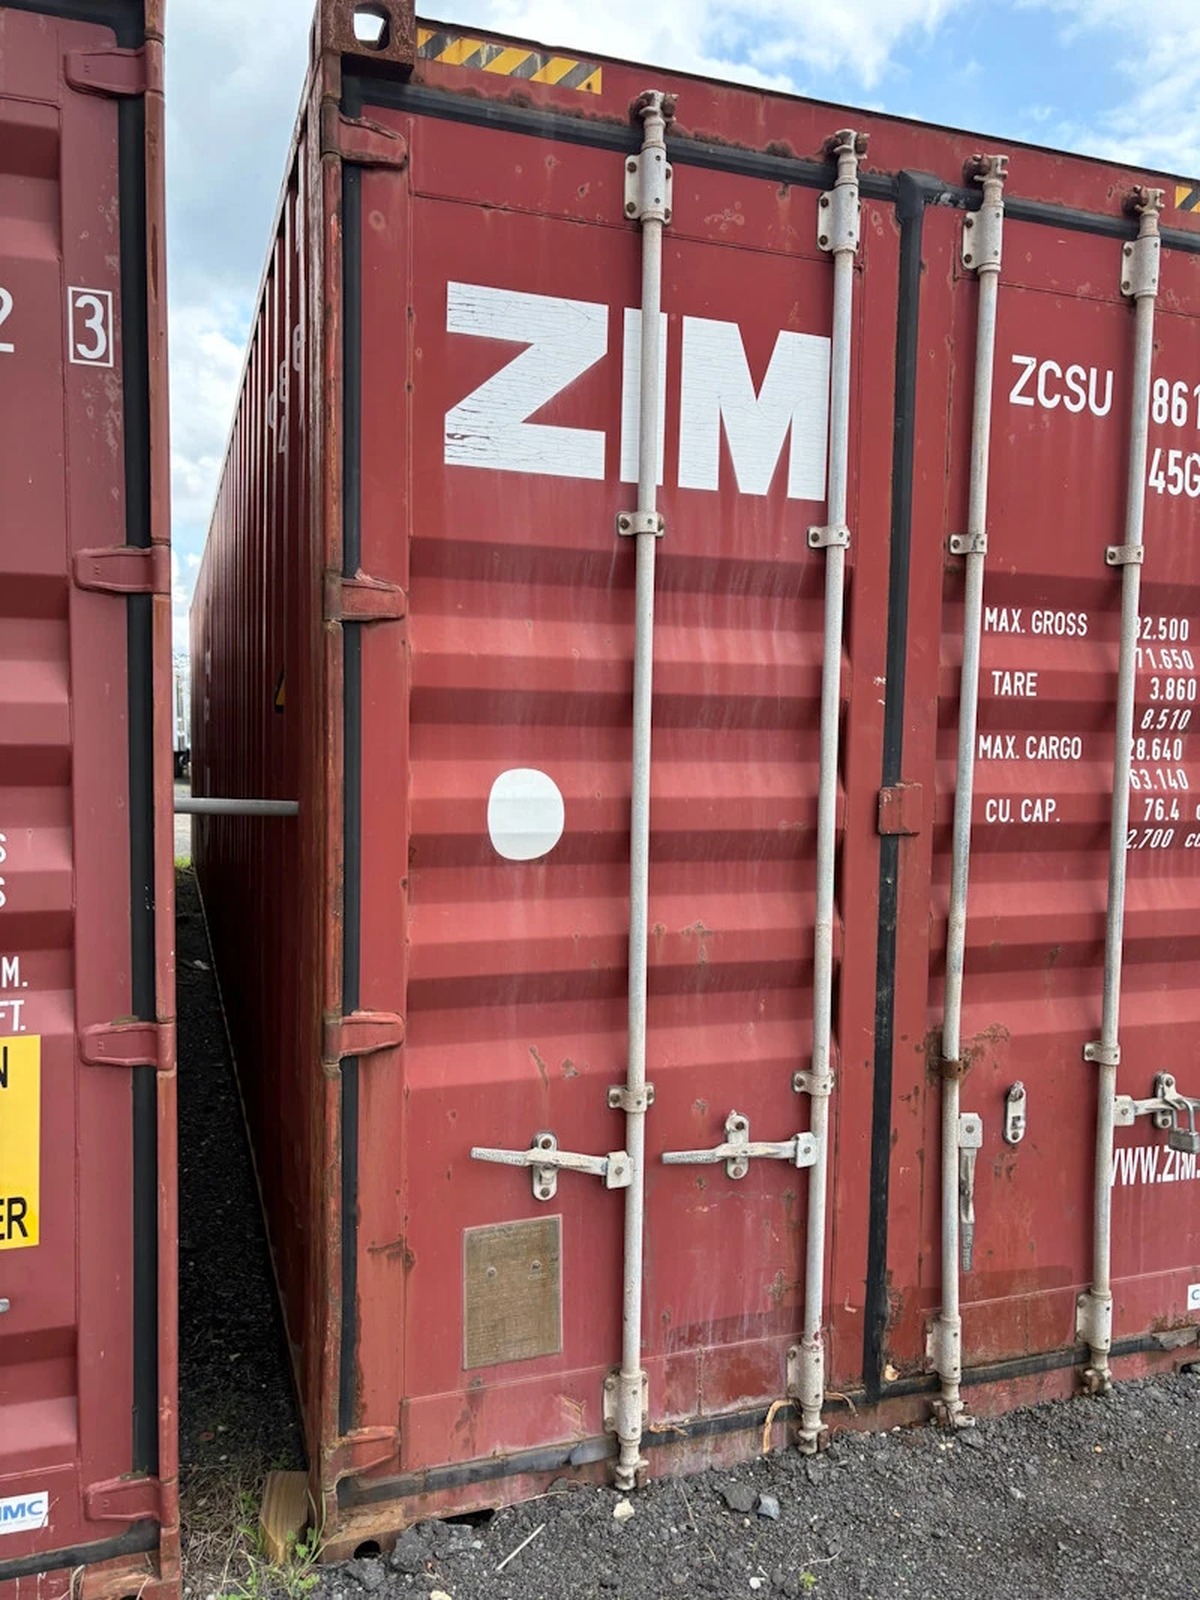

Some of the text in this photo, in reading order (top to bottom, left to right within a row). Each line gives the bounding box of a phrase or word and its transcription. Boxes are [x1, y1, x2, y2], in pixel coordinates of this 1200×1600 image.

[75, 295, 108, 359] 3
[444, 281, 831, 501] ZIM
[1009, 354, 1114, 416] ZCSU
[1148, 447, 1200, 498] 45G
[984, 607, 1026, 634] MAX.
[1031, 610, 1088, 636] GROSS
[991, 671, 1196, 701] TARE 3.860
[1141, 708, 1192, 730] 8.510
[978, 735, 1020, 760] MAX.
[1025, 736, 1082, 760] CARGO
[1129, 768, 1189, 790] 63.140
[985, 798, 1015, 822] CU.
[1020, 798, 1061, 823] CAP.
[1144, 798, 1180, 821] 76.4
[0, 1499, 44, 1522] MC
